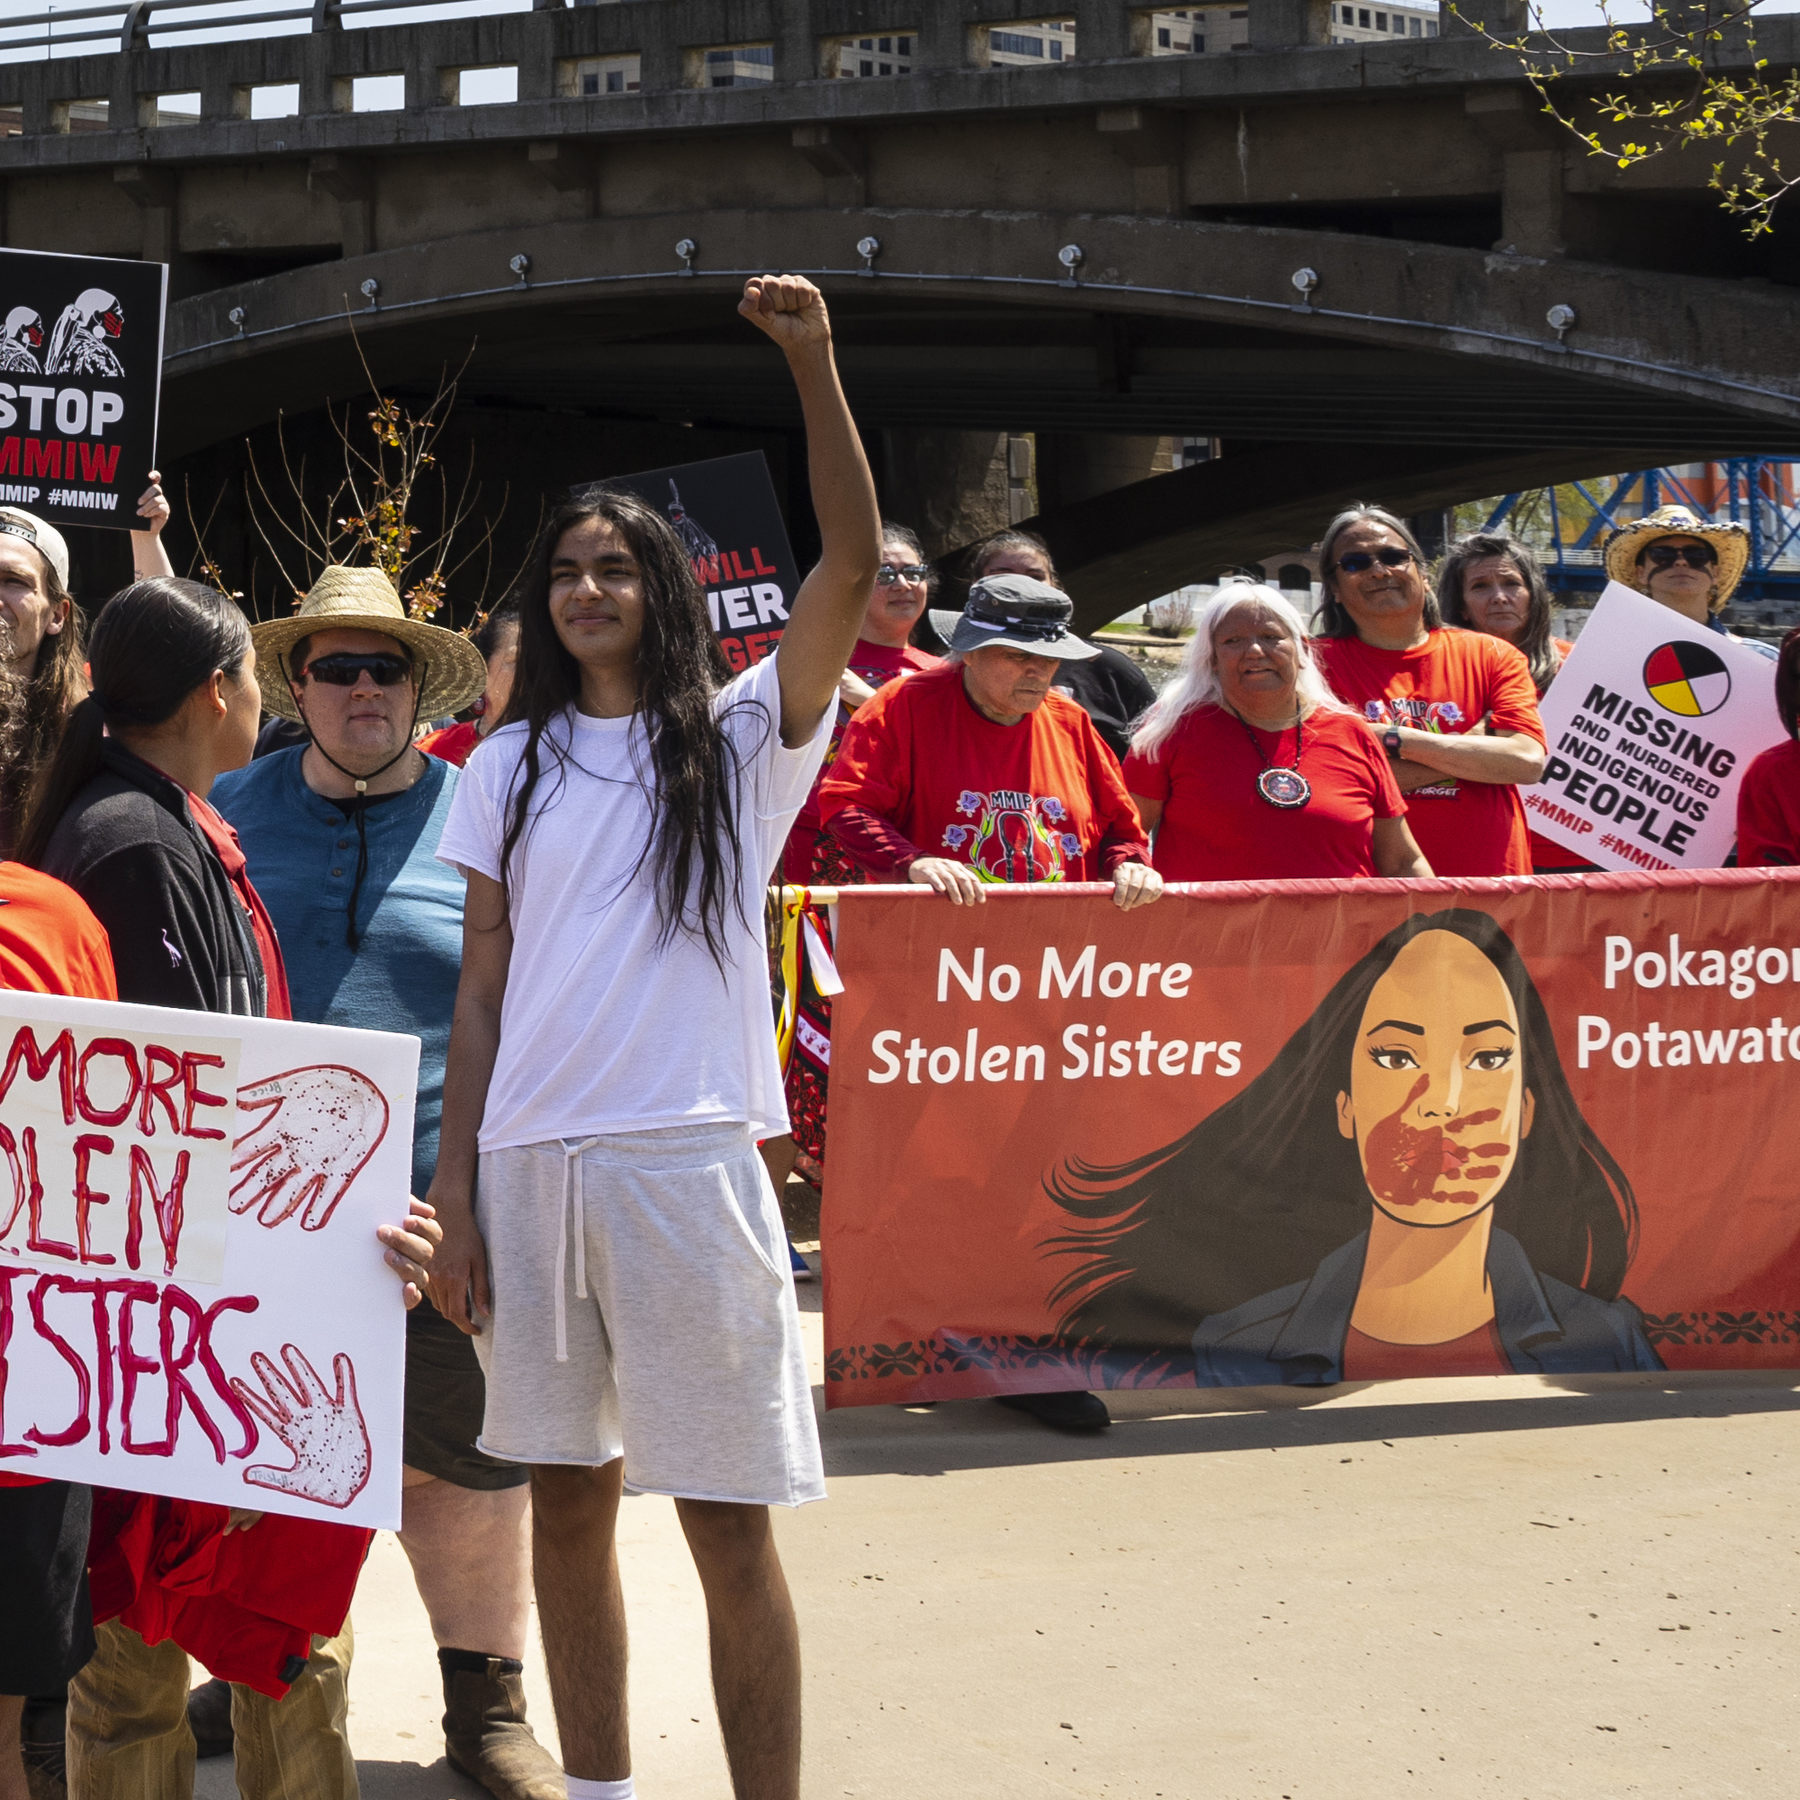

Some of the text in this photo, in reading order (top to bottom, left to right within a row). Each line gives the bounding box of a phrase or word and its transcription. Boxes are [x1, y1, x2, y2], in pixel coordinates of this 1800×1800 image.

[47, 487, 119, 510] #MMIW
[691, 547, 777, 586] WILL
[720, 630, 786, 672] GE
[1570, 714, 1720, 800] AND MURDERED
[1582, 683, 1736, 778] MISSING
[990, 790, 1033, 809] MMIP
[1557, 732, 1709, 822] INDIGENOUS
[1524, 793, 1594, 834] #MMIP
[1539, 755, 1697, 857] PEOPLE
[937, 945, 1193, 1002] No More
[868, 1023, 1242, 1084] Stolen Sisters
